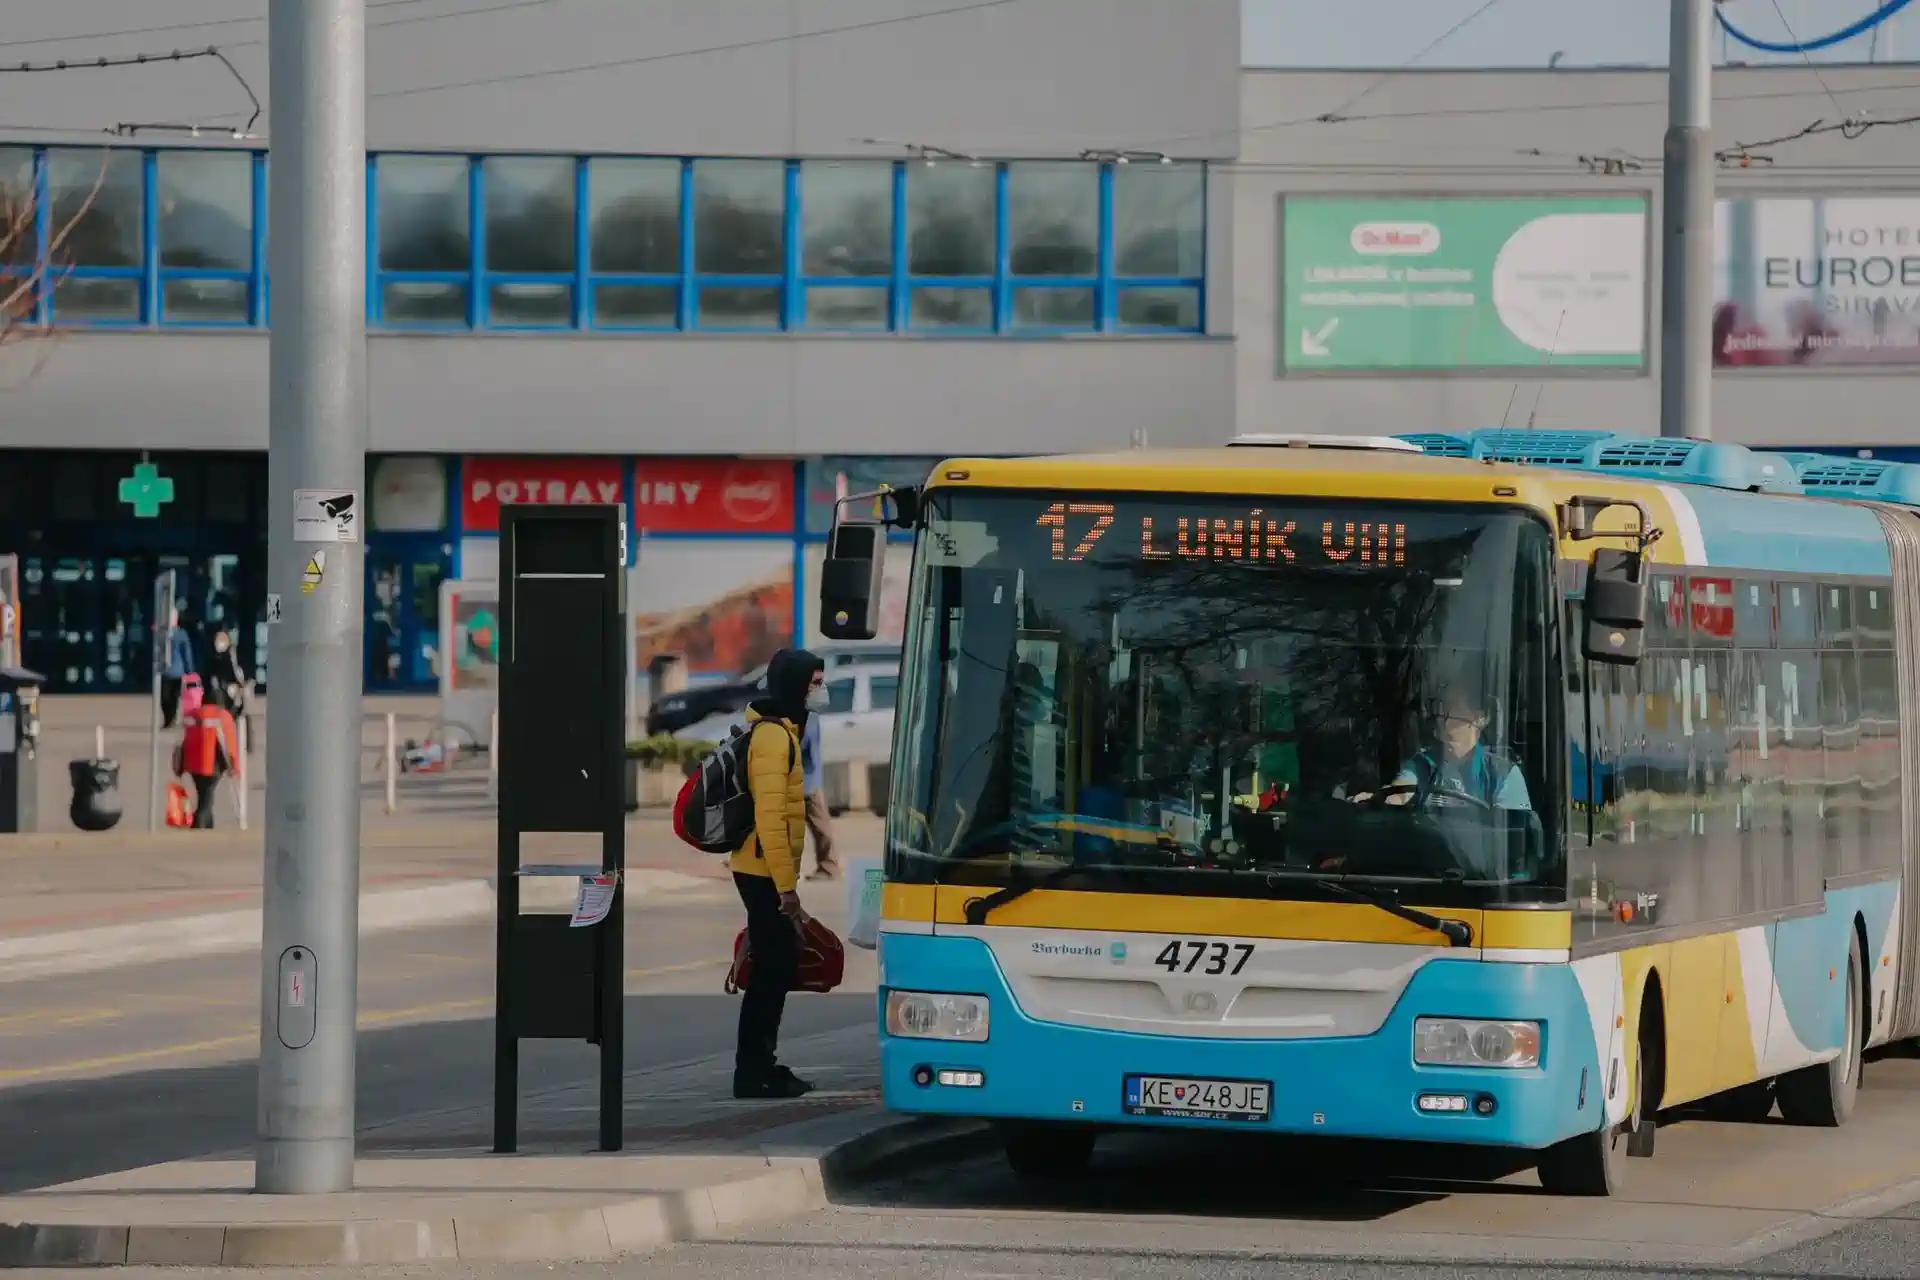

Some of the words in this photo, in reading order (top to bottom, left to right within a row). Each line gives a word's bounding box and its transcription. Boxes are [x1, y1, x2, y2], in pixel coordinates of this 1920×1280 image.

[1036, 503, 1115, 561] 17
[1142, 507, 1298, 565] LUNÍK
[1154, 940, 1255, 976] 4737
[1142, 1080, 1173, 1105] KE
[1187, 1083, 1264, 1111] 248JE
